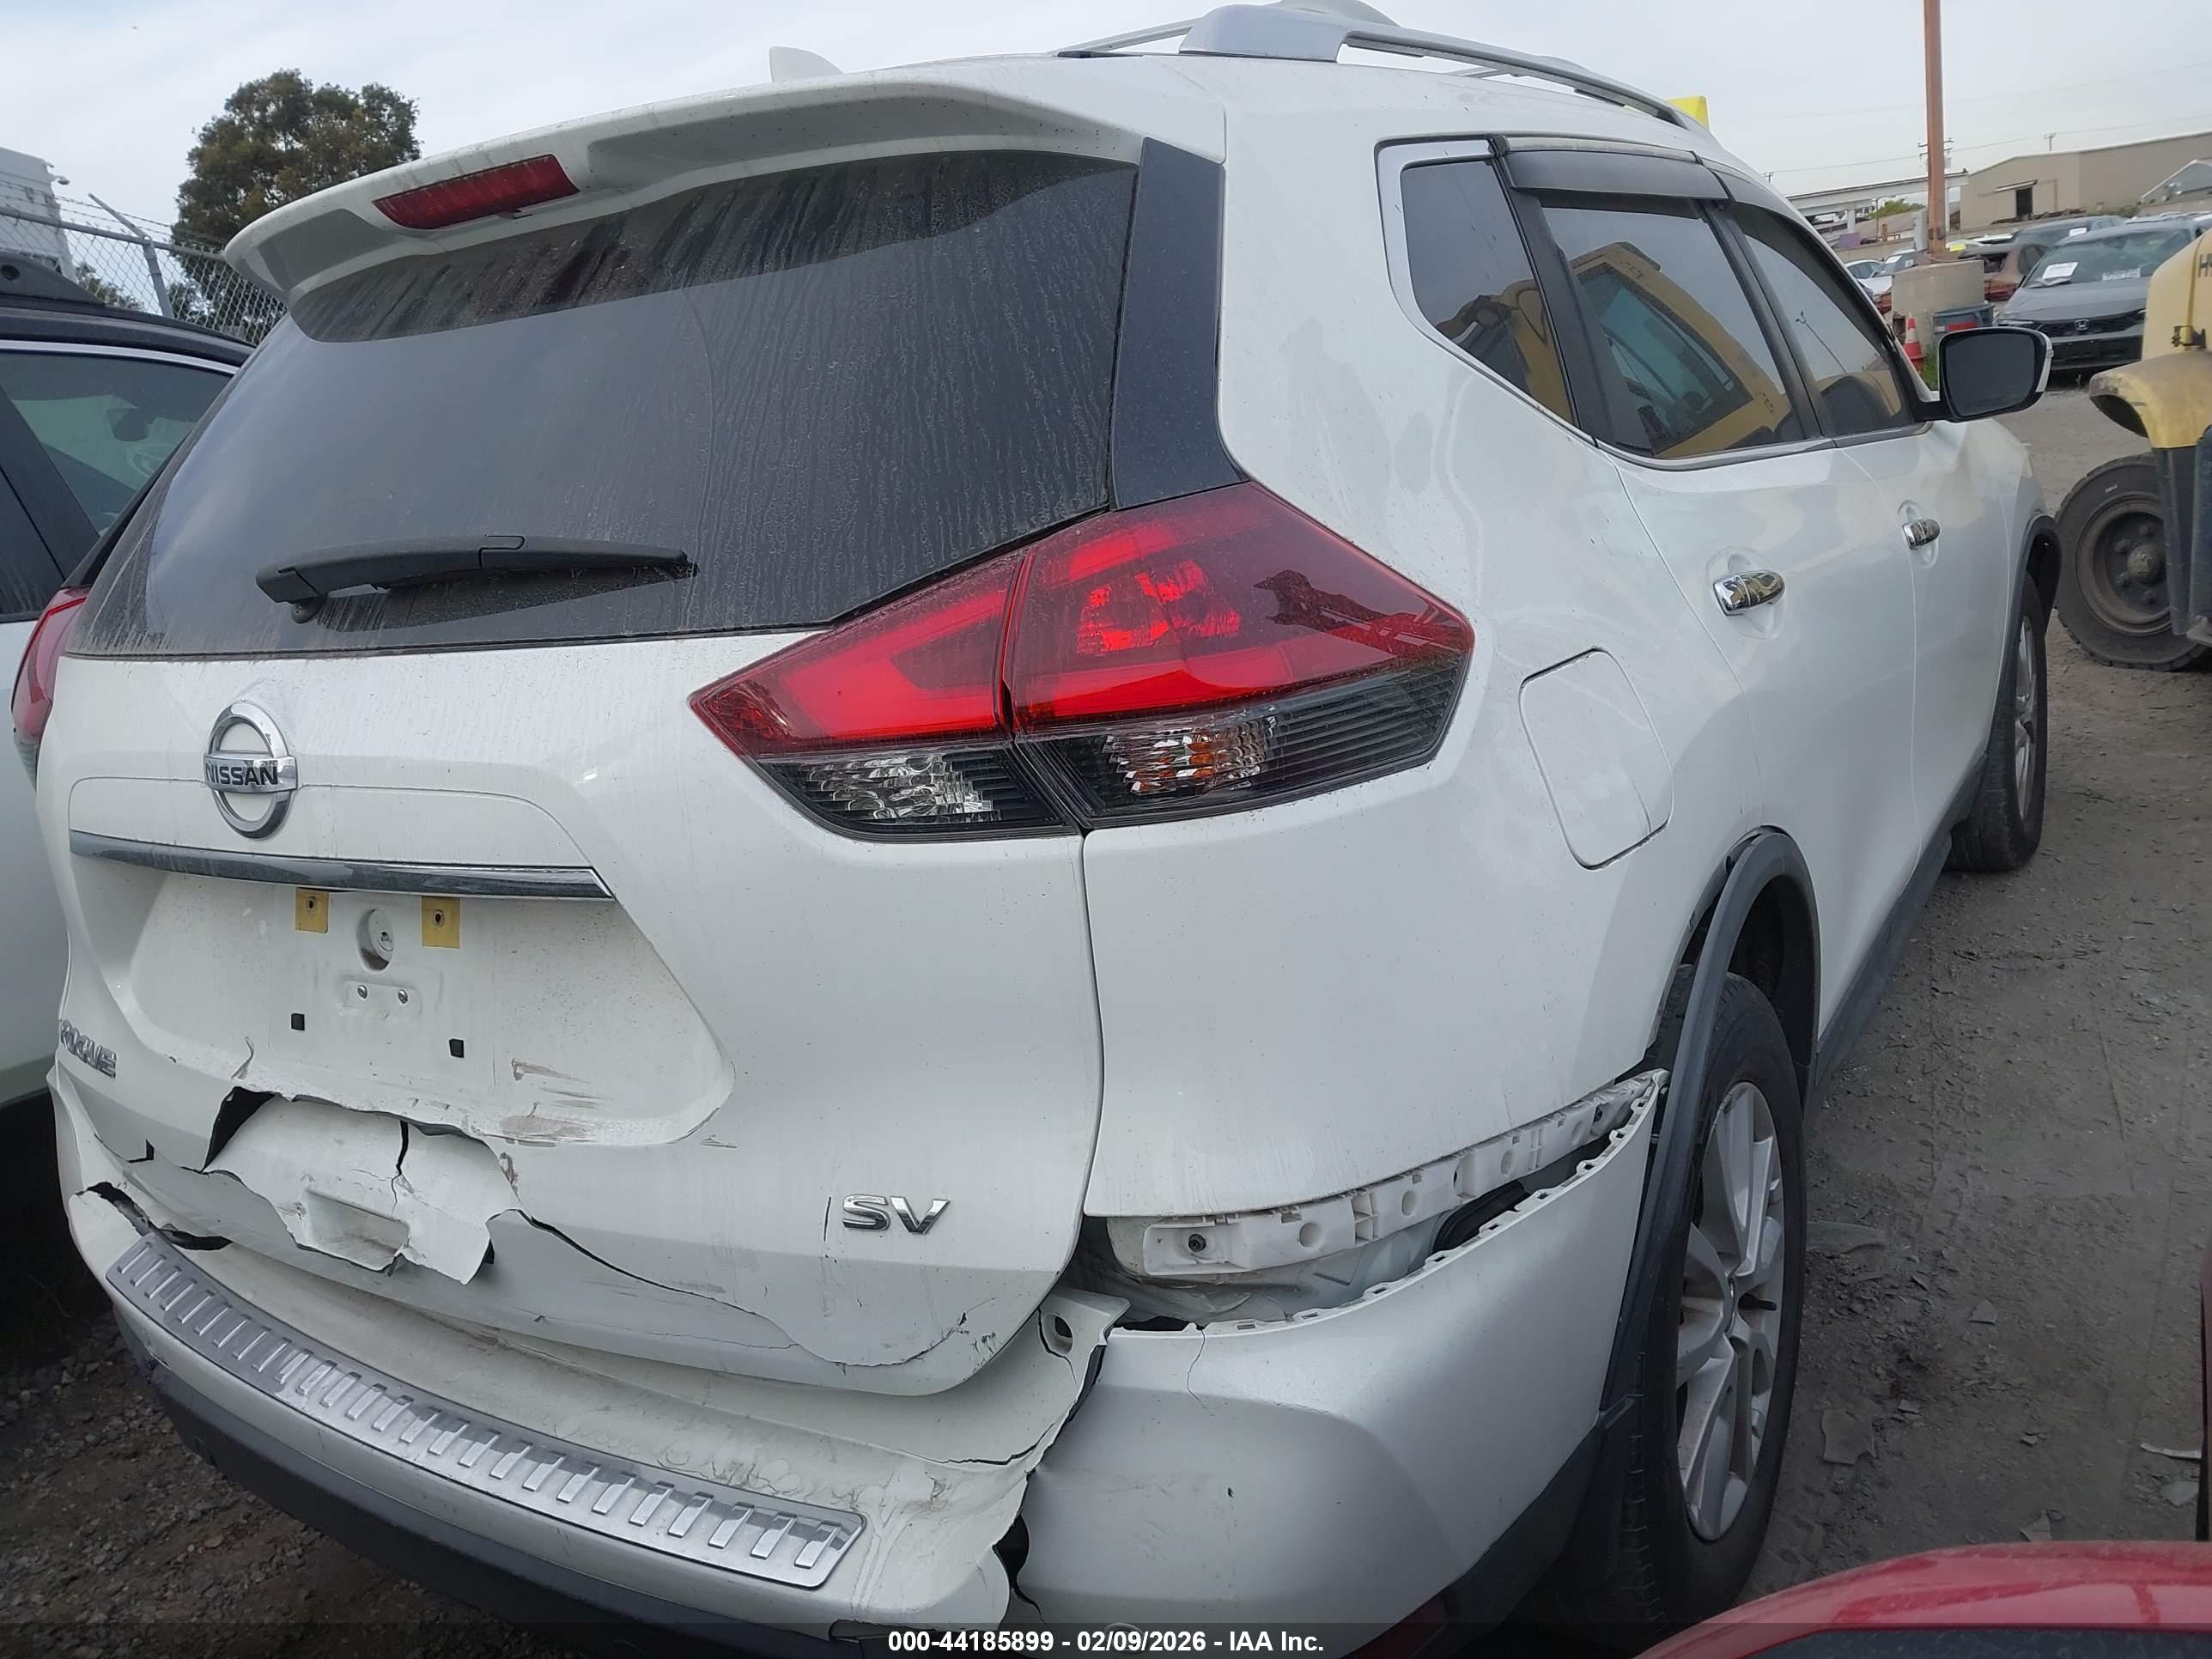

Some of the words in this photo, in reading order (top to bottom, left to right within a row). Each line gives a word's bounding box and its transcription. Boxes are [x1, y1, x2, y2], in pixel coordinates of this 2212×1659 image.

[205, 761, 279, 786] NISSAN
[61, 1019, 117, 1079] ROGUE
[842, 1194, 951, 1235] SV
